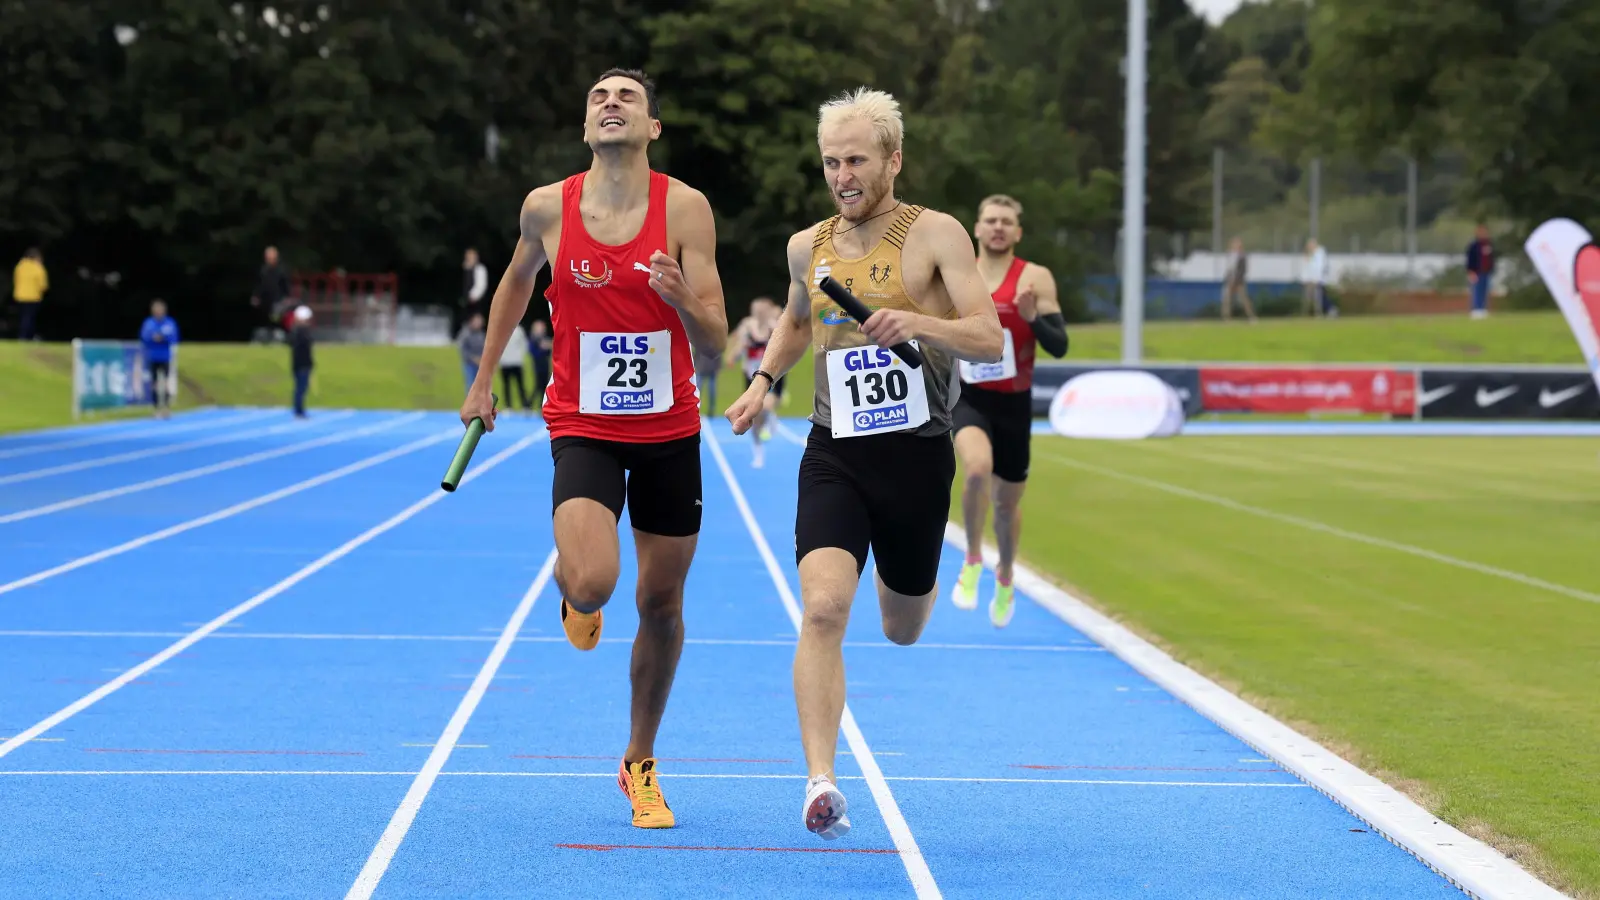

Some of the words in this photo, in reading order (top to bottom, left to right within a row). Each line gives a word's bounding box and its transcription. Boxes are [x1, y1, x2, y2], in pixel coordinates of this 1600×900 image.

[574, 277, 592, 289] Region
[607, 357, 648, 388] 23
[844, 369, 908, 407] 130
[623, 393, 652, 404] PLAN
[874, 408, 906, 421] PLAN
